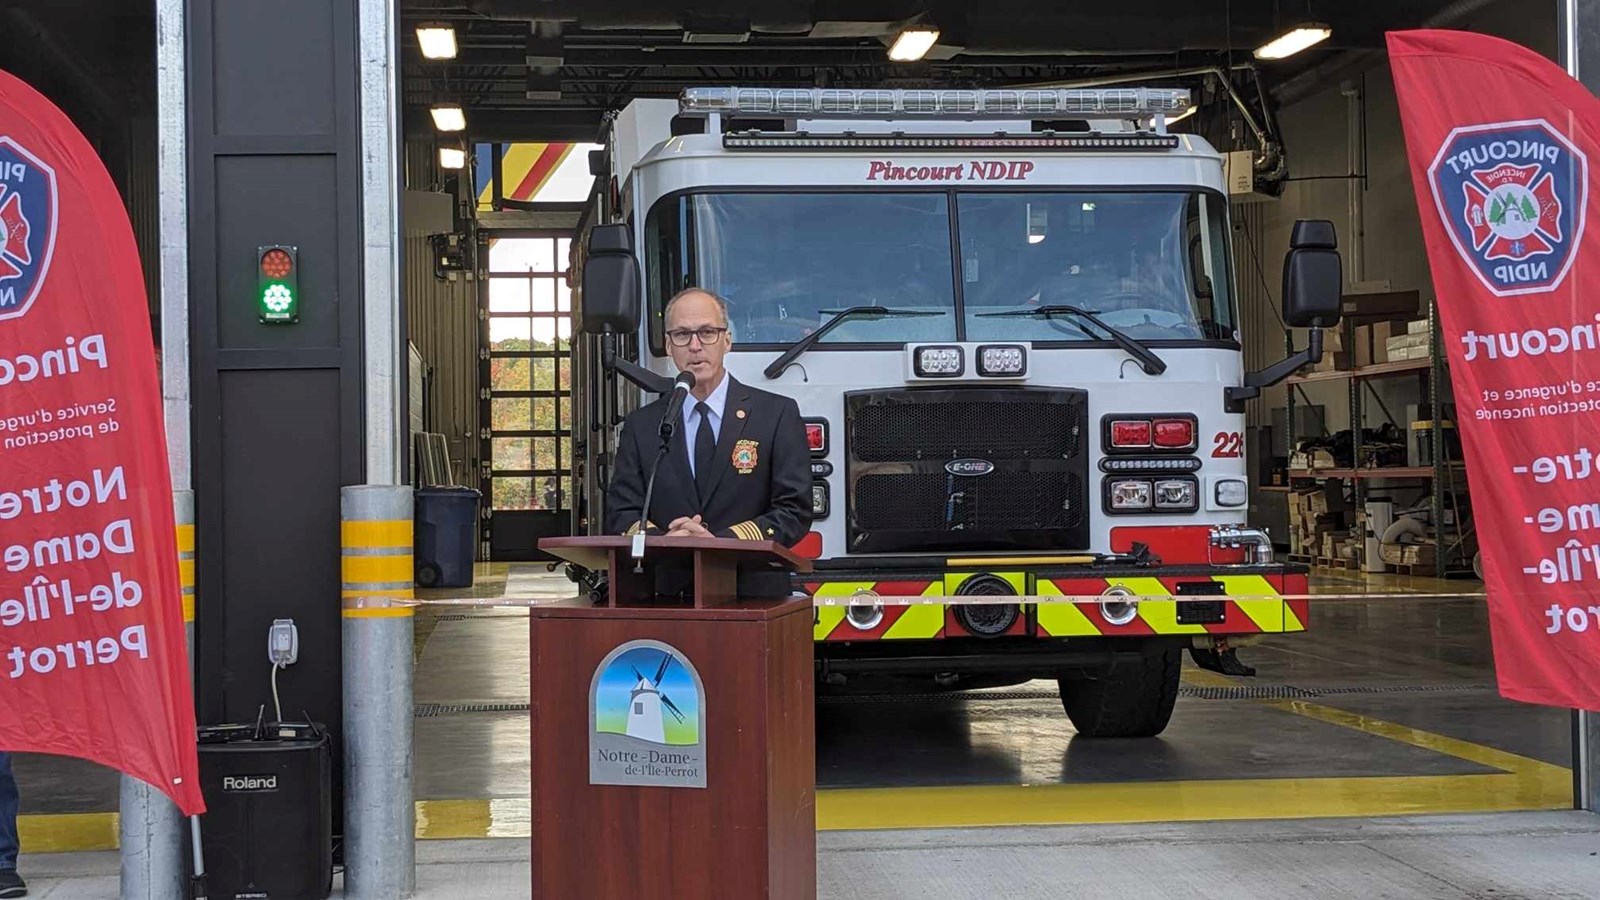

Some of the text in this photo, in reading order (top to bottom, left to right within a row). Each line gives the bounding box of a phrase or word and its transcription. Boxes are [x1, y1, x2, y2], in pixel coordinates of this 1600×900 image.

[866, 161, 1034, 180] Pincourt NDIP
[952, 462, 987, 471] E-ONE
[223, 775, 277, 790] Roland
